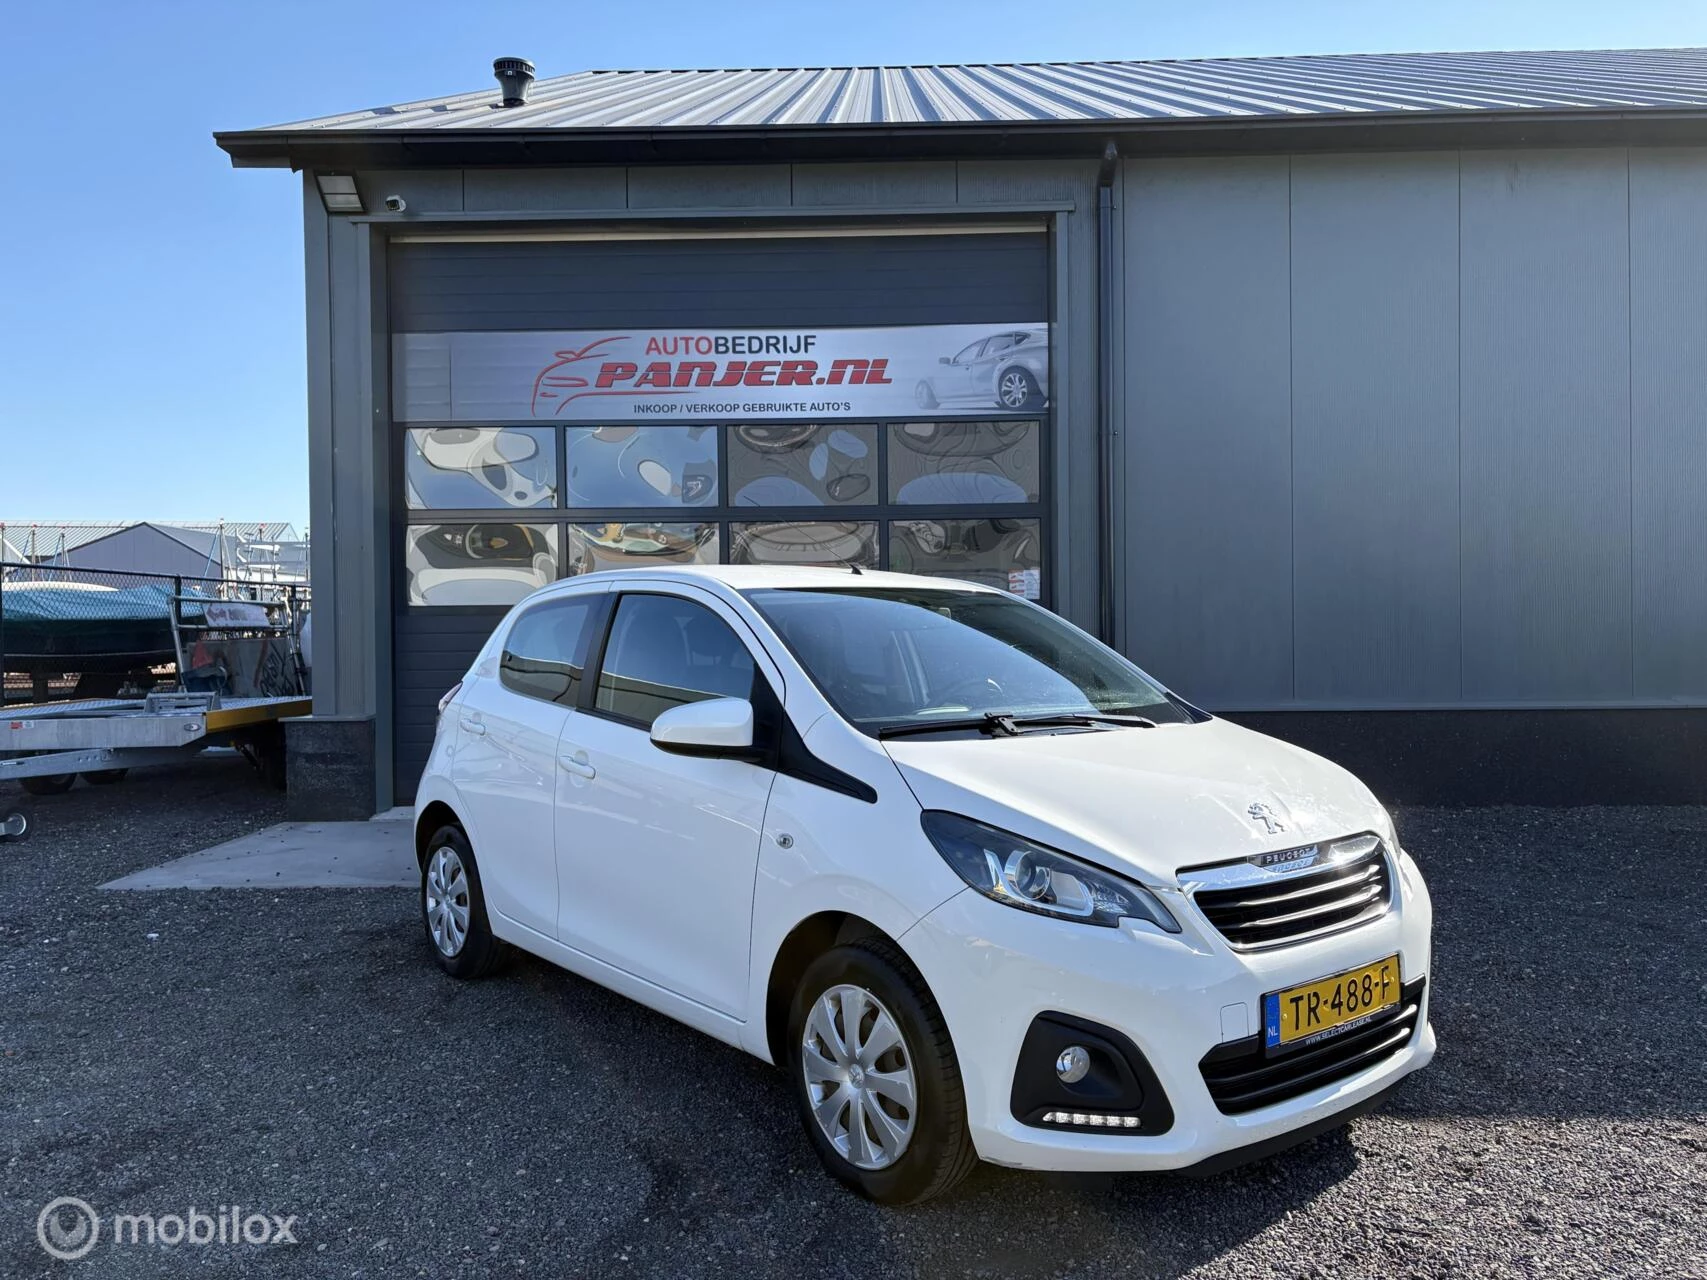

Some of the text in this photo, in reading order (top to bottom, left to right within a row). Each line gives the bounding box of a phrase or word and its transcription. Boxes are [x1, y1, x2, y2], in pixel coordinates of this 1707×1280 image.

[645, 335, 817, 355] AUTOBEDRIJF
[595, 358, 893, 388] PANJER.NL
[633, 404, 677, 414] INKOOP
[686, 403, 740, 413] VERKOOP
[742, 403, 807, 412] GEBRUIKTE
[809, 402, 851, 412] AUTO'S
[1266, 847, 1310, 864] PEUGEOT
[1268, 965, 1390, 1037] NL TR-488-F
